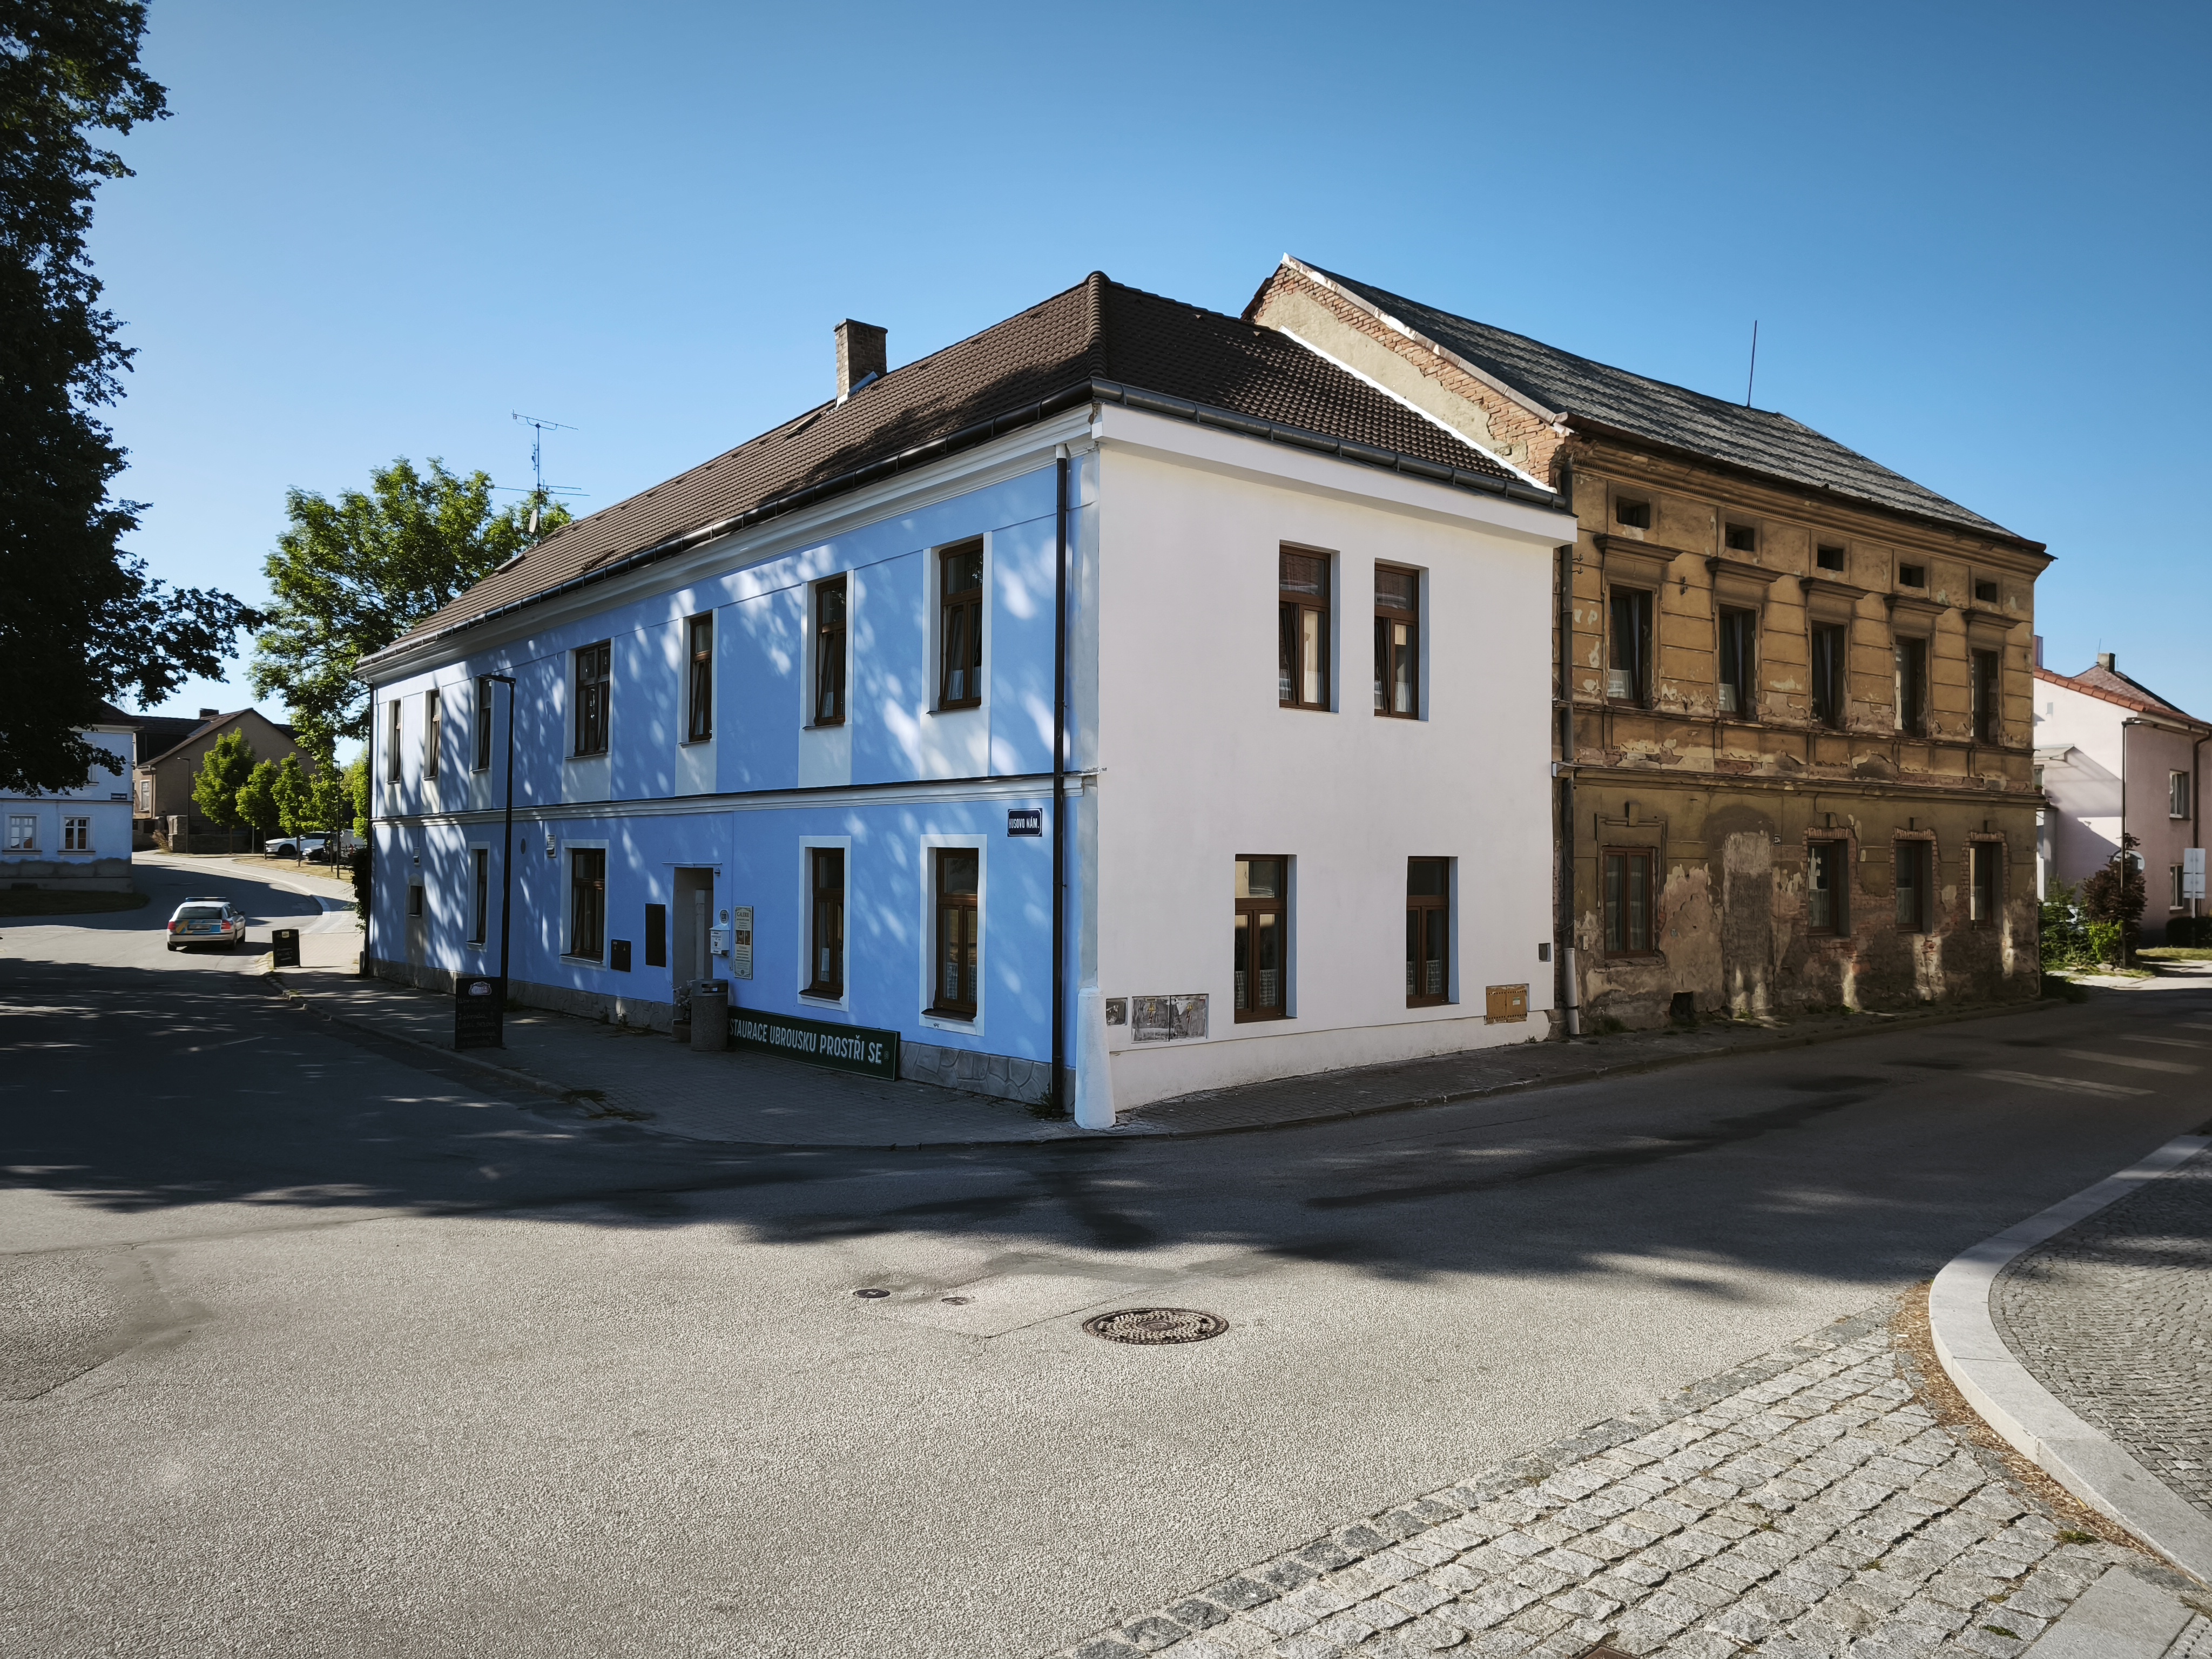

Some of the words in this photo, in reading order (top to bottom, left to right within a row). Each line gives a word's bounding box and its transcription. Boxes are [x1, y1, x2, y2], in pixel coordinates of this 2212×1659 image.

[1009, 818, 1025, 829] HUSOVO
[1026, 816, 1039, 829] NÁM.
[729, 1017, 768, 1042] STAURACE
[770, 1025, 817, 1053] UBROUSKU
[819, 1034, 865, 1061] PROSTŘI
[868, 1042, 883, 1064] SE
